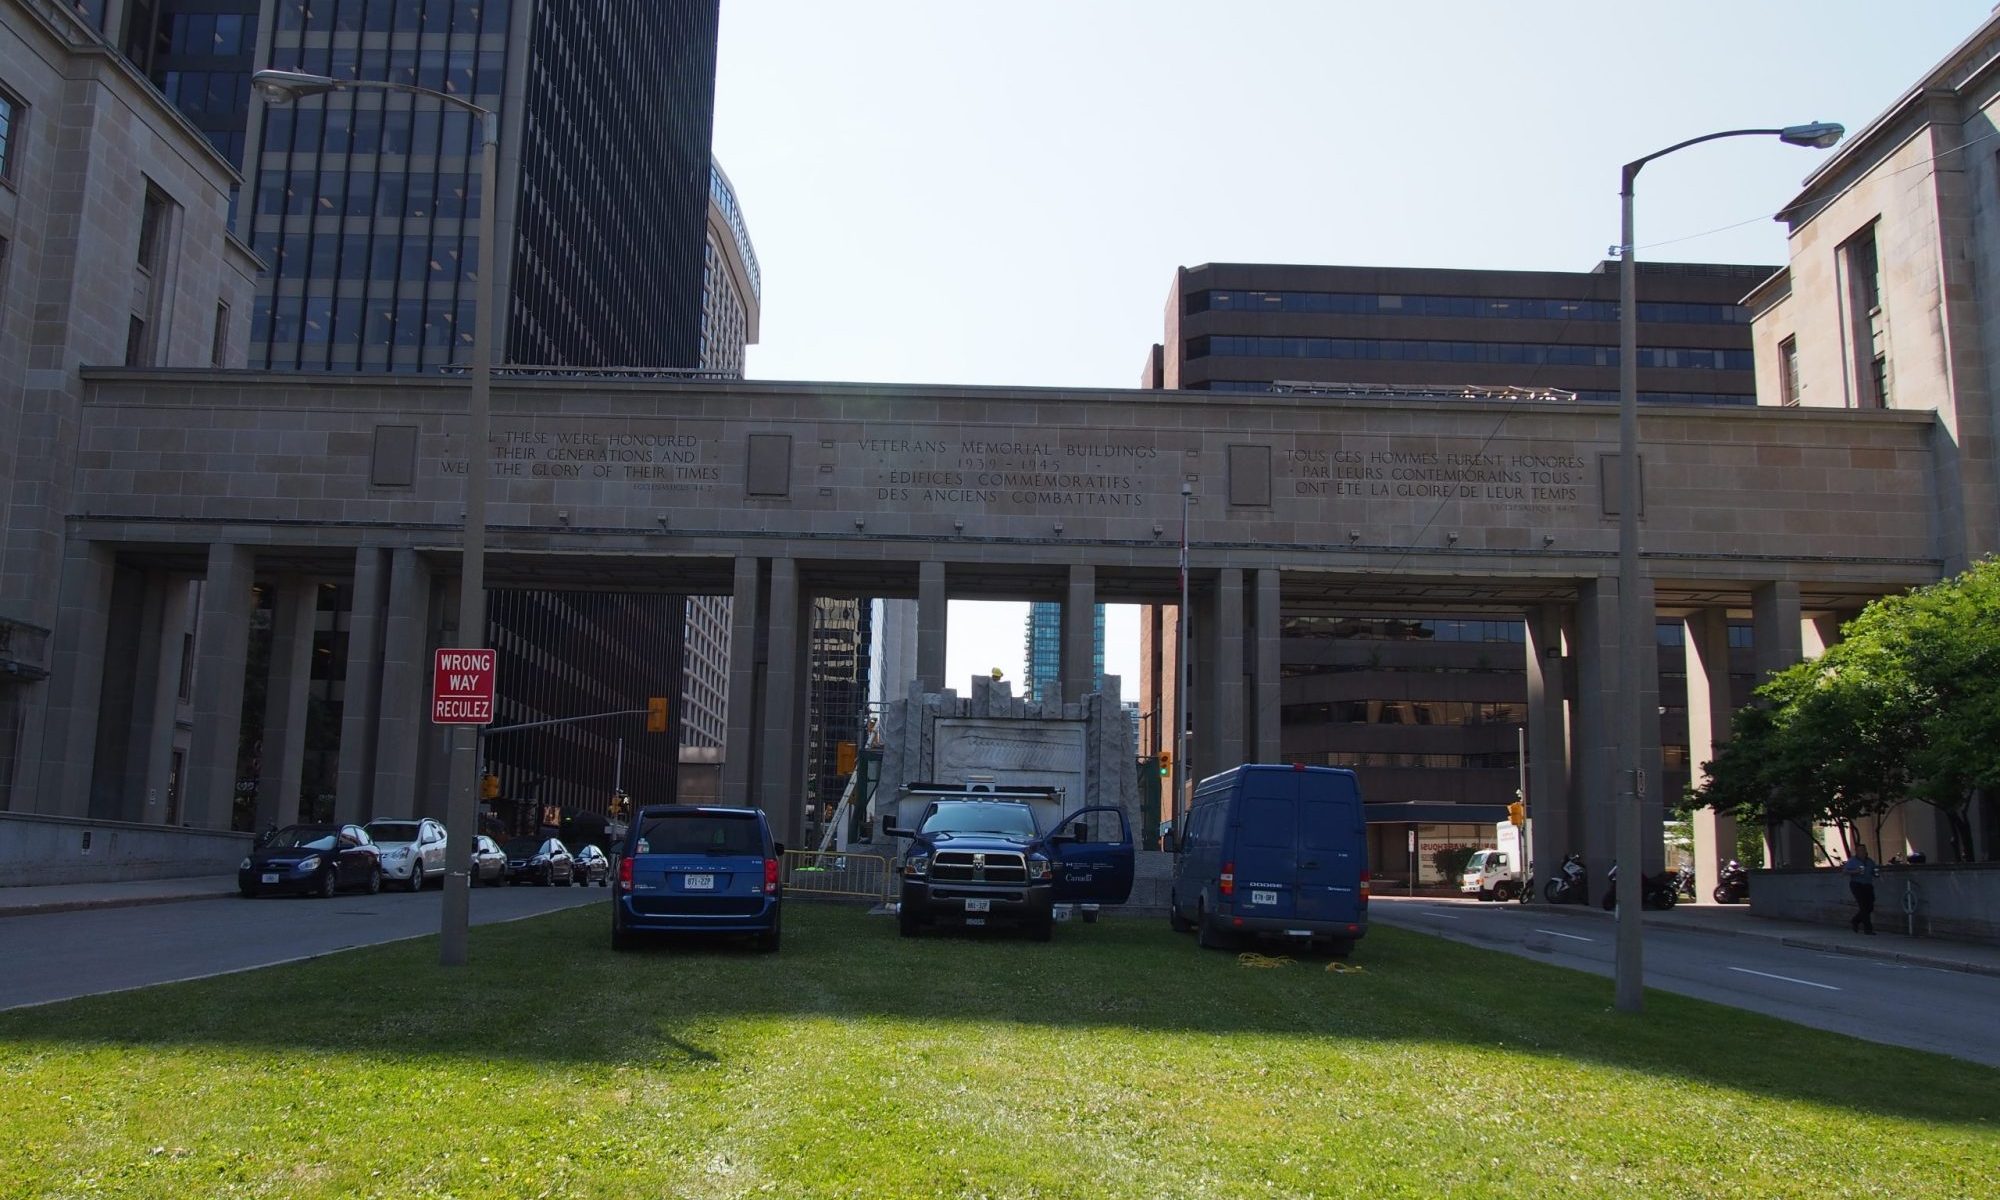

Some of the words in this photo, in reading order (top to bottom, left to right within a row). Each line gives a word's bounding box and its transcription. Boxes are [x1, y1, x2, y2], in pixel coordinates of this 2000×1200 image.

[506, 431, 548, 445] THESE
[557, 432, 600, 446] WERE
[609, 433, 697, 448] HONOURED
[857, 439, 947, 454] VETERANS
[960, 441, 1052, 456] MEMORIAL
[1066, 443, 1157, 458] BUILDINGS
[495, 446, 537, 460] THEIR
[547, 447, 652, 462] GENERATIONS
[662, 450, 695, 464] AND
[1286, 449, 1326, 463] TOUS
[1334, 450, 1361, 464] CES
[1371, 451, 1438, 465] HOMMES
[1447, 452, 1504, 466] FURENT
[494, 462, 522, 475] THE
[532, 463, 583, 477] GLORY
[593, 464, 613, 478] OF
[624, 465, 665, 479] THEIR
[676, 466, 720, 481] TIMES
[957, 457, 997, 470] 1939
[1021, 459, 1060, 472] 1945
[1302, 465, 1330, 479] PAR
[1337, 466, 1383, 480] LEURS
[1391, 468, 1521, 483] CONTEMPORAINS
[1530, 470, 1570, 485] TOUS
[878, 487, 909, 501] DES
[923, 488, 997, 503] ANCIENS
[1011, 490, 1143, 506] COMBATTANTS
[1295, 481, 1329, 495] ONT
[1371, 483, 1390, 496] LA
[1396, 483, 1451, 498] GLOIRE
[1459, 485, 1479, 498] DE
[1487, 486, 1523, 499] LEUR
[1532, 487, 1577, 501] TEMPS
[441, 654, 490, 671] WRONG
[450, 674, 479, 691] WAY
[436, 700, 490, 718] RECULEZ
